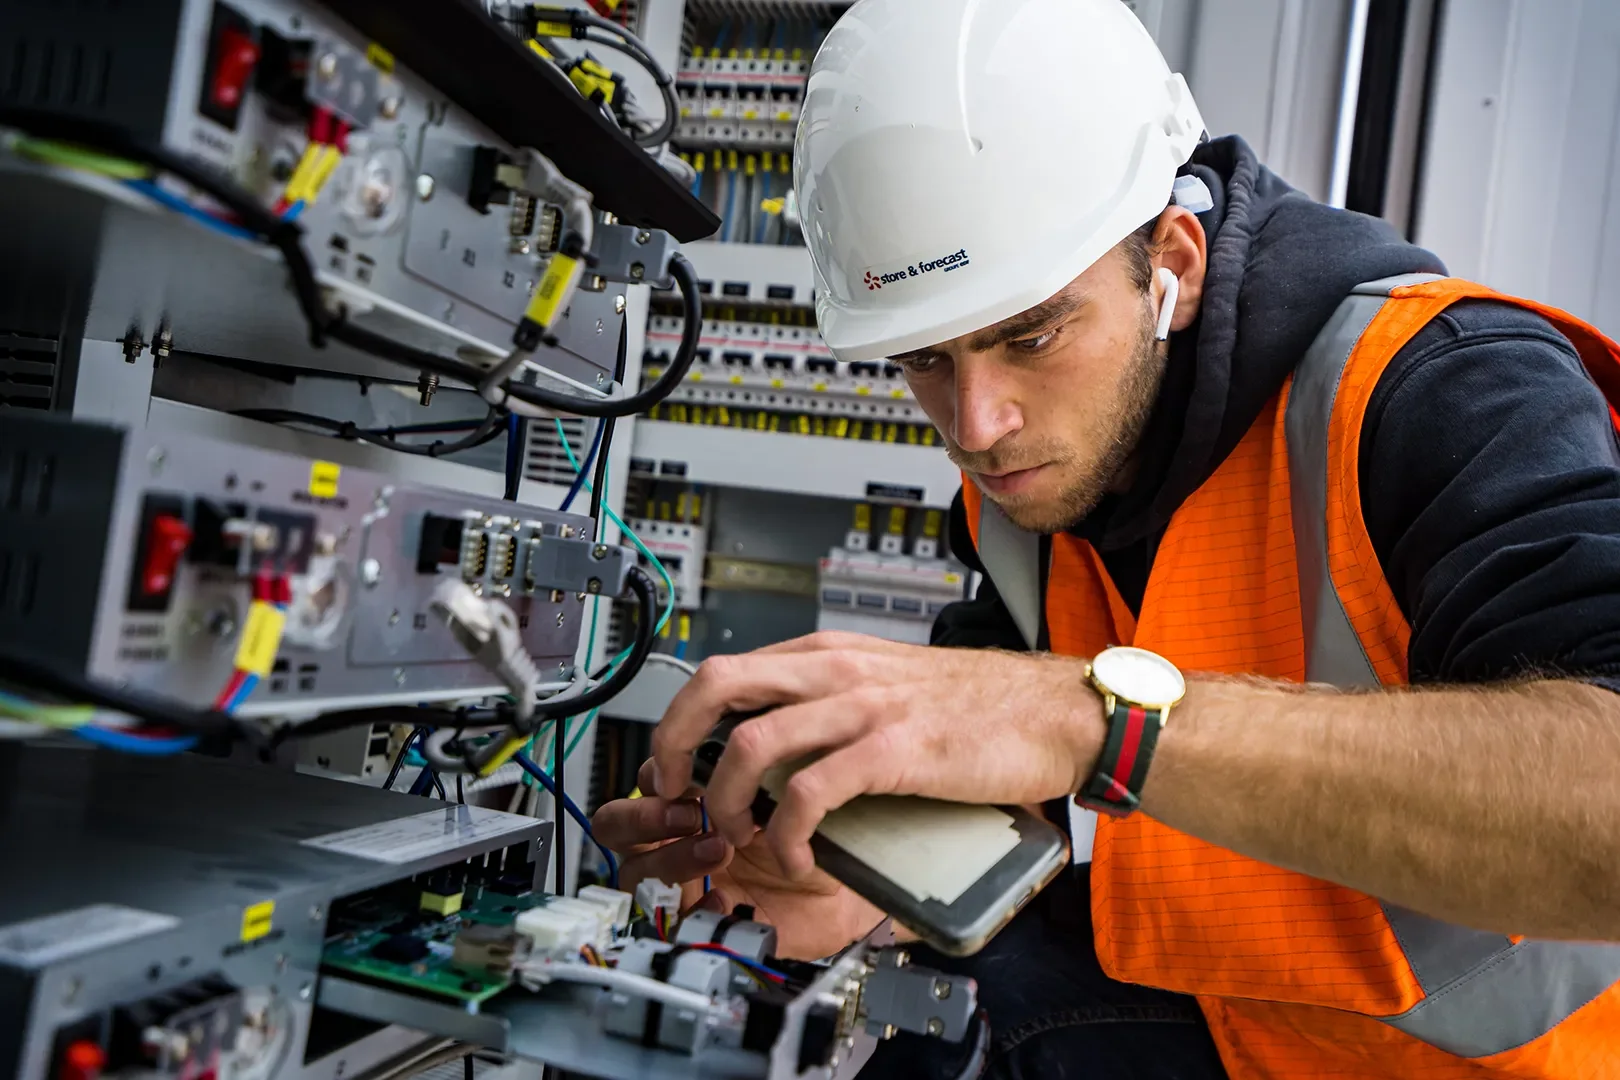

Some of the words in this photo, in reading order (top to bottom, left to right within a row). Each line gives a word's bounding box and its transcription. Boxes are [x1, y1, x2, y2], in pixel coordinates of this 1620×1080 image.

[880, 270, 907, 285] store
[907, 265, 919, 277] &
[919, 248, 968, 274] forecast
